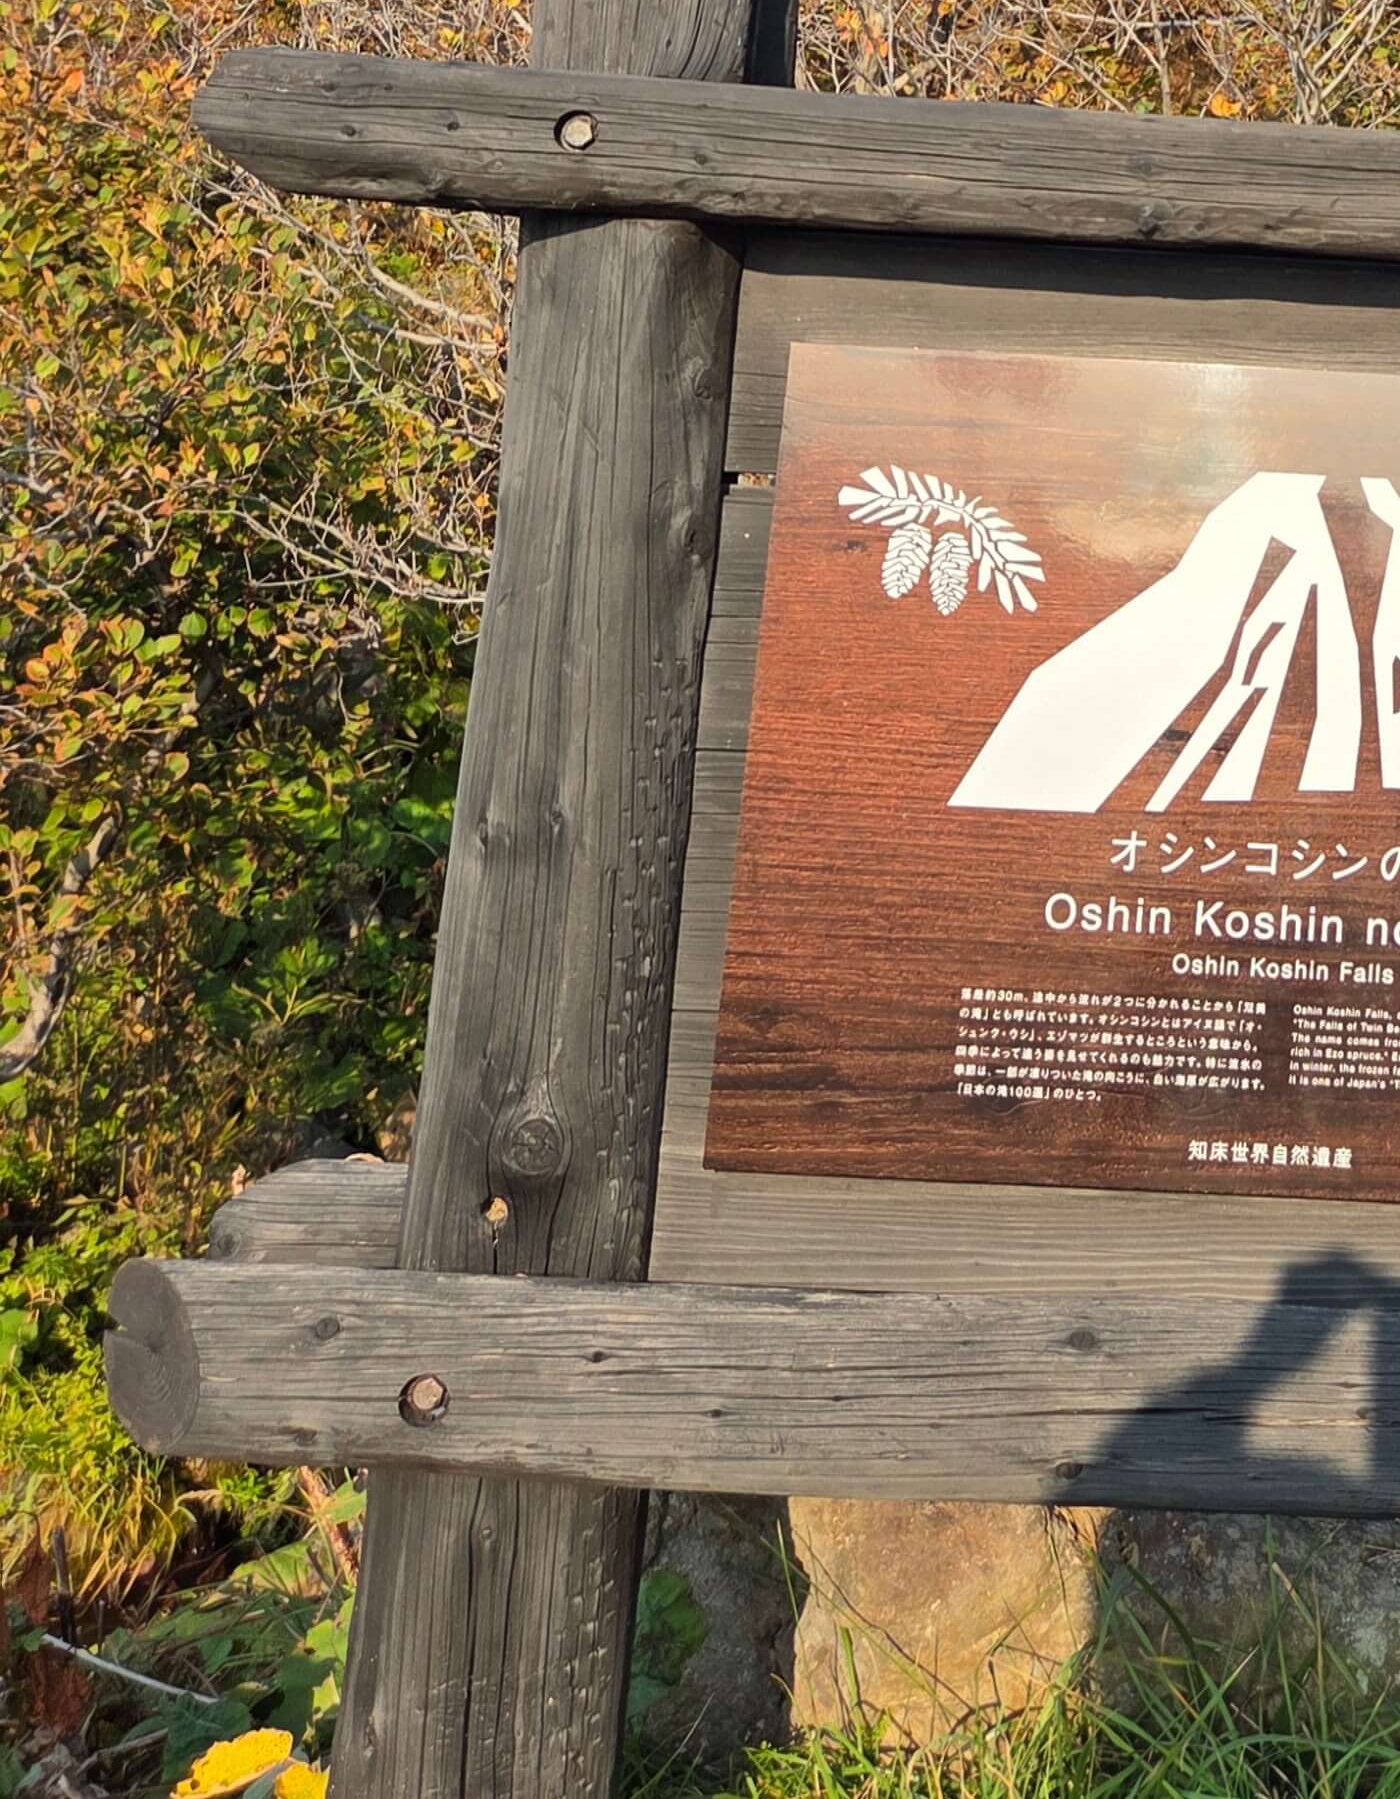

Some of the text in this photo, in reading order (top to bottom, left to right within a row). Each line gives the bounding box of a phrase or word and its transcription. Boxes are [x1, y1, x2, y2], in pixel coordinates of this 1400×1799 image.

[1046, 893, 1170, 933] Oshin
[1196, 901, 1342, 942] Koshin
[1173, 954, 1393, 984] Oshin Koshin Falls
[1294, 1005, 1322, 1015] Oshin
[1327, 1007, 1360, 1017] Koshin
[1365, 1008, 1392, 1020] Falls,
[1320, 1020, 1343, 1031] Falls
[1347, 1022, 1357, 1031] of
[1361, 1022, 1383, 1032] Twin
[1292, 1032, 1310, 1043] The
[1315, 1036, 1342, 1044] name
[1347, 1037, 1379, 1046] comes
[1291, 1047, 1310, 1057] rich
[1326, 1048, 1344, 1059] Ezo
[1303, 1062, 1335, 1072] winter,
[1340, 1063, 1355, 1073] the
[1359, 1064, 1389, 1075] frozen
[1312, 1077, 1330, 1086] one
[1334, 1077, 1344, 1086] of
[1347, 1078, 1385, 1089] Japan's
[1189, 1140, 1352, 1168] 知床世界自然遺産
